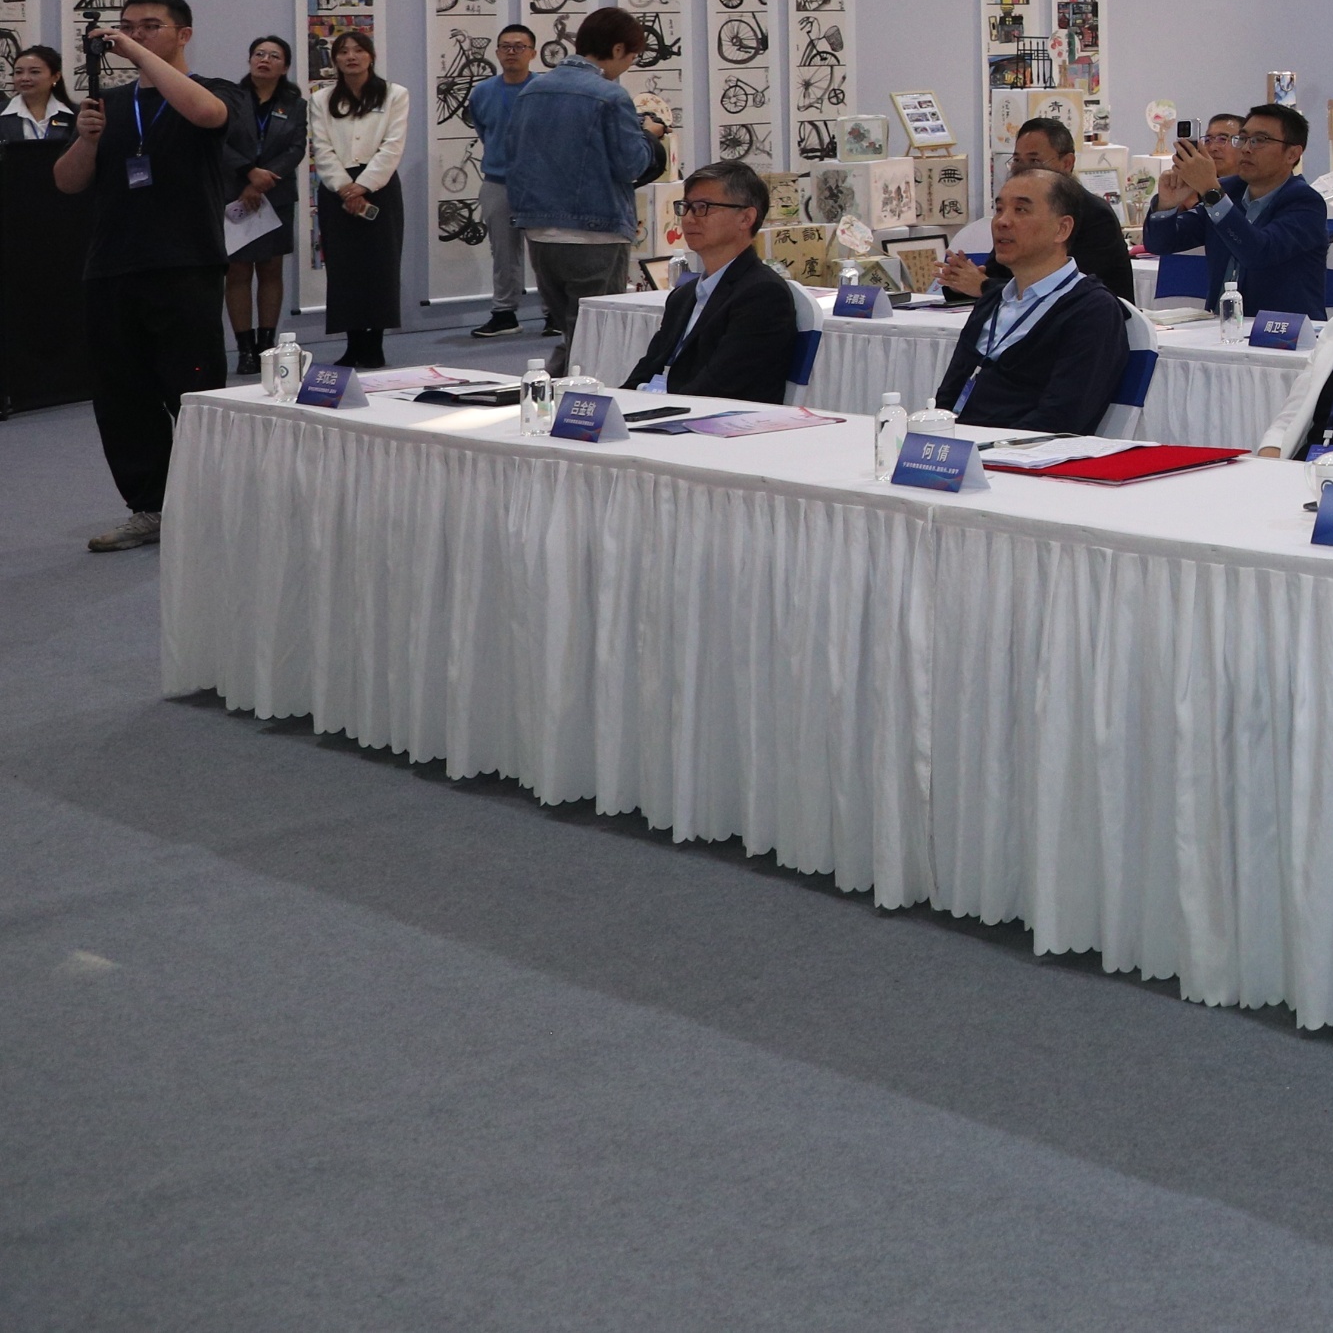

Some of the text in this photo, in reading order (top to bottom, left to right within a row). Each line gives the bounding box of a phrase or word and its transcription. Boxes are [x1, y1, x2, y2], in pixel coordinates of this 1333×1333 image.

[1263, 320, 1290, 335] 周卫军
[921, 442, 951, 463] 何倩
